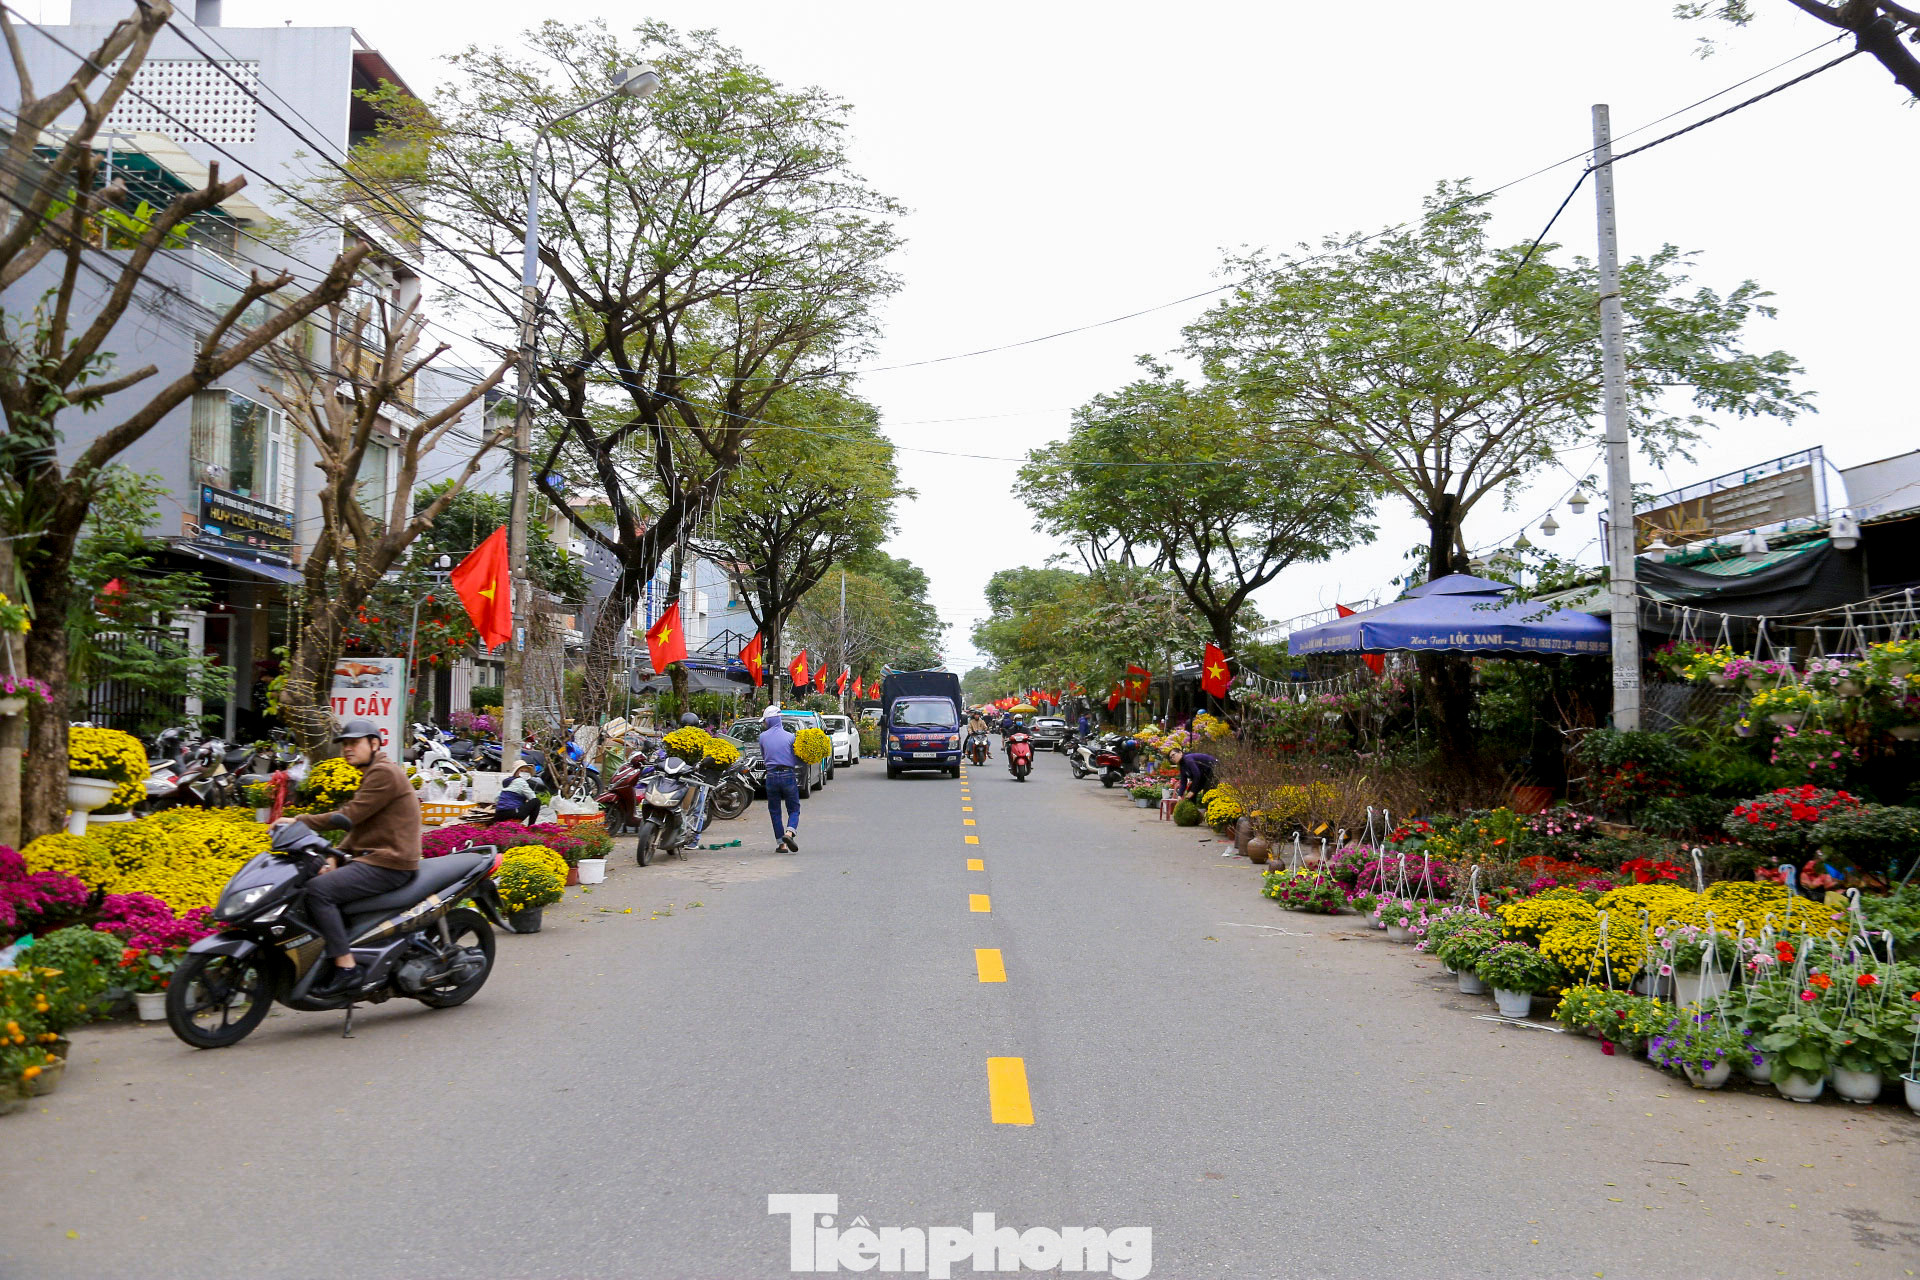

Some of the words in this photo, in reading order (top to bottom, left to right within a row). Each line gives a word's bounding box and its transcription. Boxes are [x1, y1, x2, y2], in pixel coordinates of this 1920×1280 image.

[209, 506, 230, 523] HUY
[231, 512, 256, 530] CÔNG
[1449, 631, 1470, 648] LỘC
[1473, 634, 1502, 645] XANH
